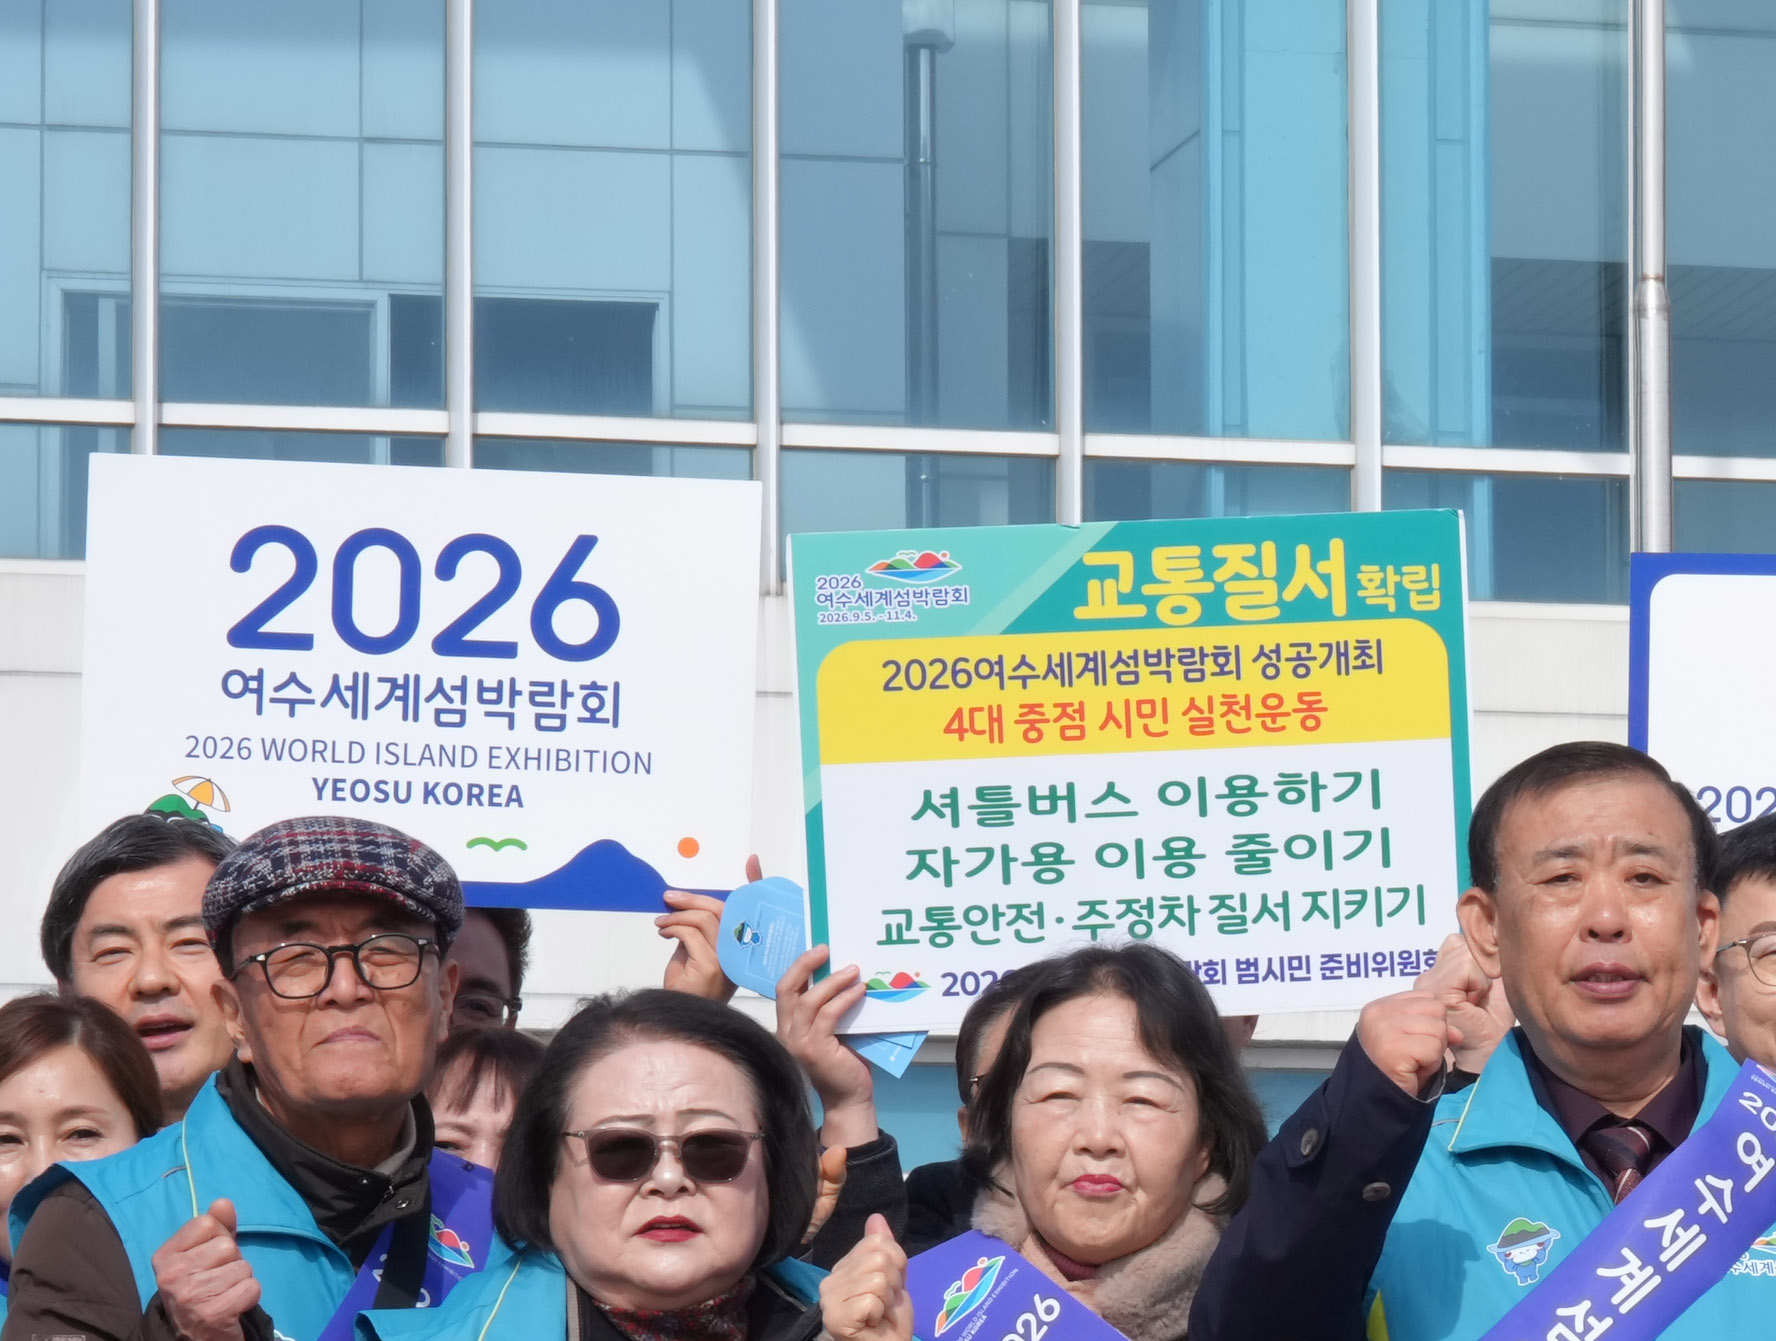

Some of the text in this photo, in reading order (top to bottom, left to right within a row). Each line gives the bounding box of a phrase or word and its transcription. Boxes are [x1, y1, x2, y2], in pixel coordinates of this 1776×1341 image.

[226, 524, 620, 662] 2026
[817, 575, 862, 591] 2026
[817, 587, 969, 609] 여수세계섬박람회
[1072, 538, 1441, 626] 교통질서 확립
[882, 639, 1384, 693] 2026여수세계섬박람회 성공개최
[221, 667, 621, 732] 여수세계섬박람회
[943, 691, 1328, 745] 4대 중점 시민 실천운동
[184, 735, 653, 775] 2026 WORLD ISLAND EXHIBITION
[312, 777, 524, 808] YEOSU KOREA
[911, 767, 1383, 829] 셔틀버스 이용하기
[904, 827, 1392, 889] 자가용 이용 줄이기
[1209, 889, 1291, 934] 질서
[1301, 884, 1426, 930] 지키기
[1236, 955, 1312, 984] 범시민
